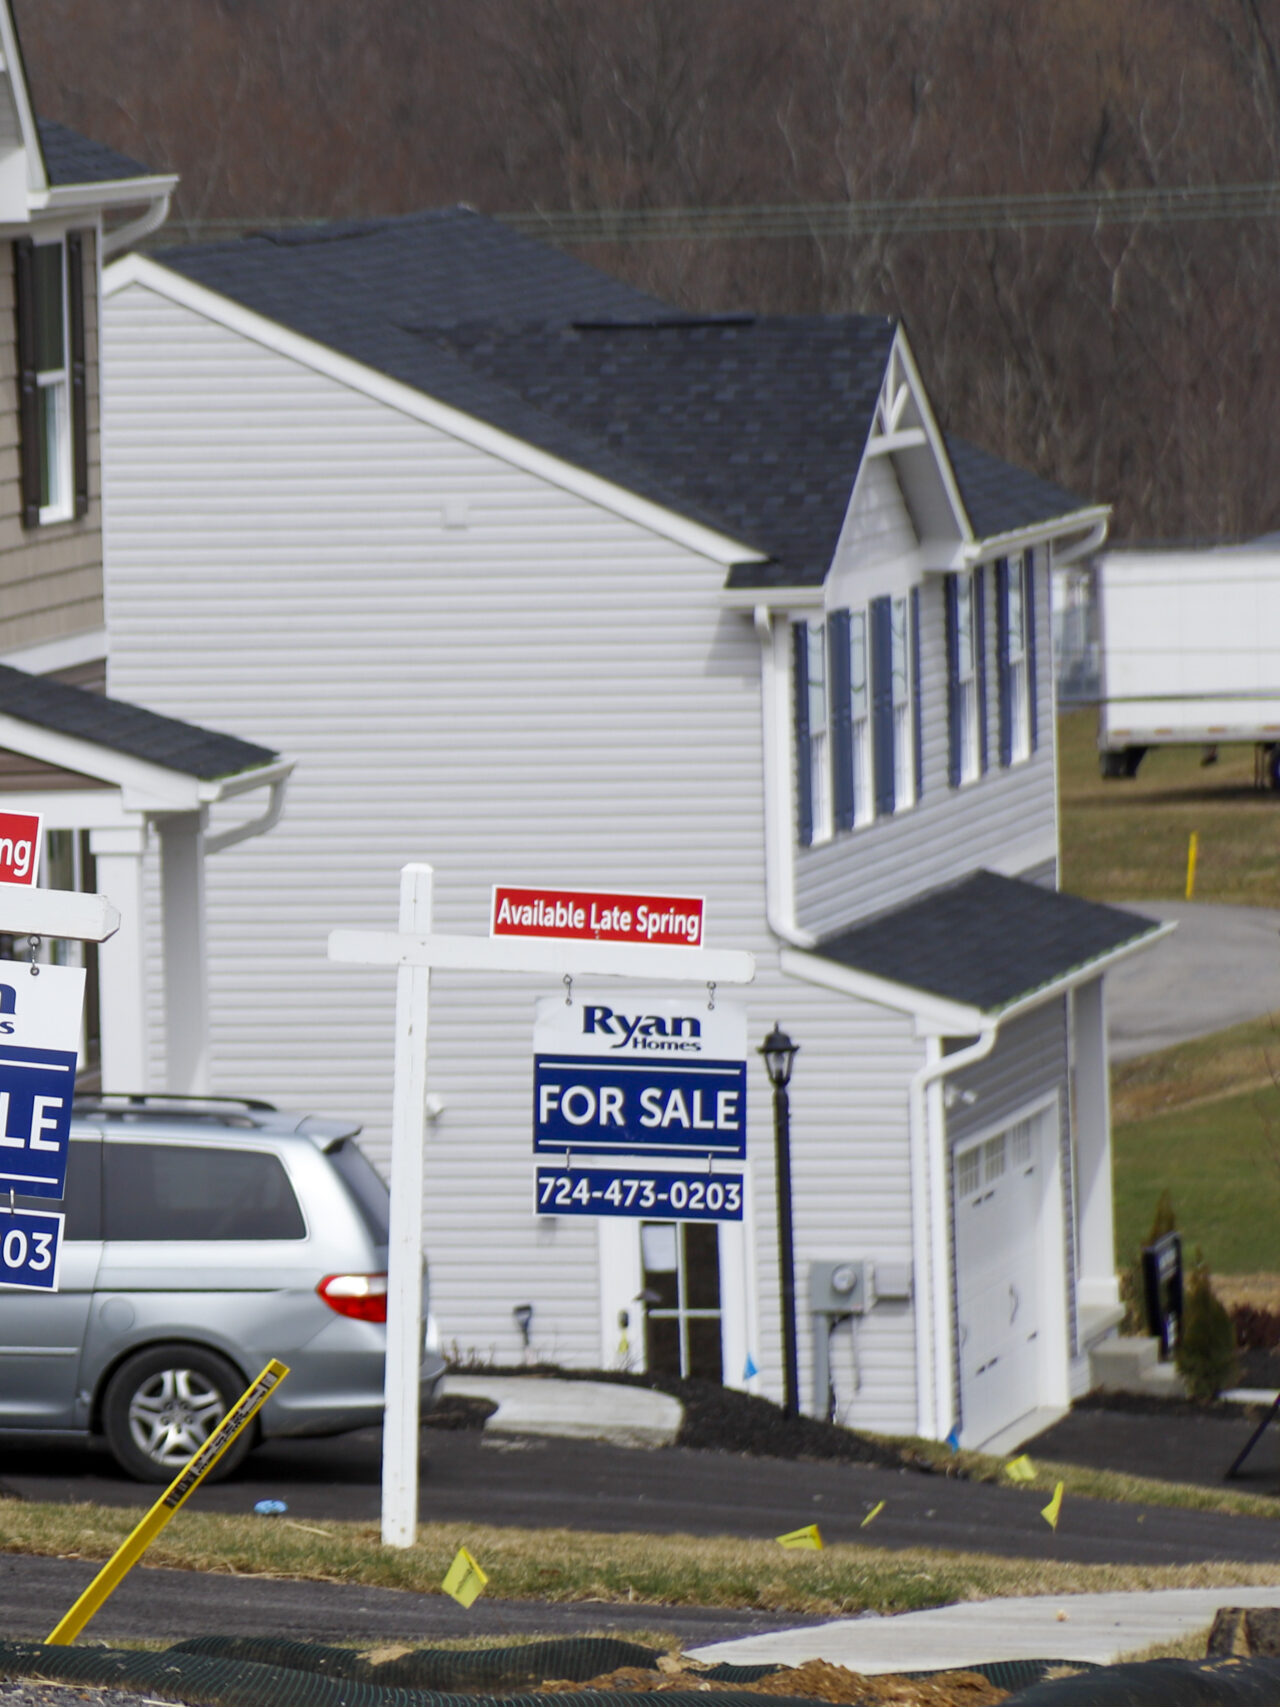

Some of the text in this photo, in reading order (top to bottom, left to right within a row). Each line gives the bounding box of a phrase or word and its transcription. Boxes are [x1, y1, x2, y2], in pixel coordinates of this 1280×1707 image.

[497, 898, 700, 942] Available Late Spring
[582, 1005, 701, 1049] Ryan
[632, 1037, 702, 1051] Homes
[539, 1085, 739, 1130] FOR SALE
[538, 1177, 741, 1211] 724-473-0203
